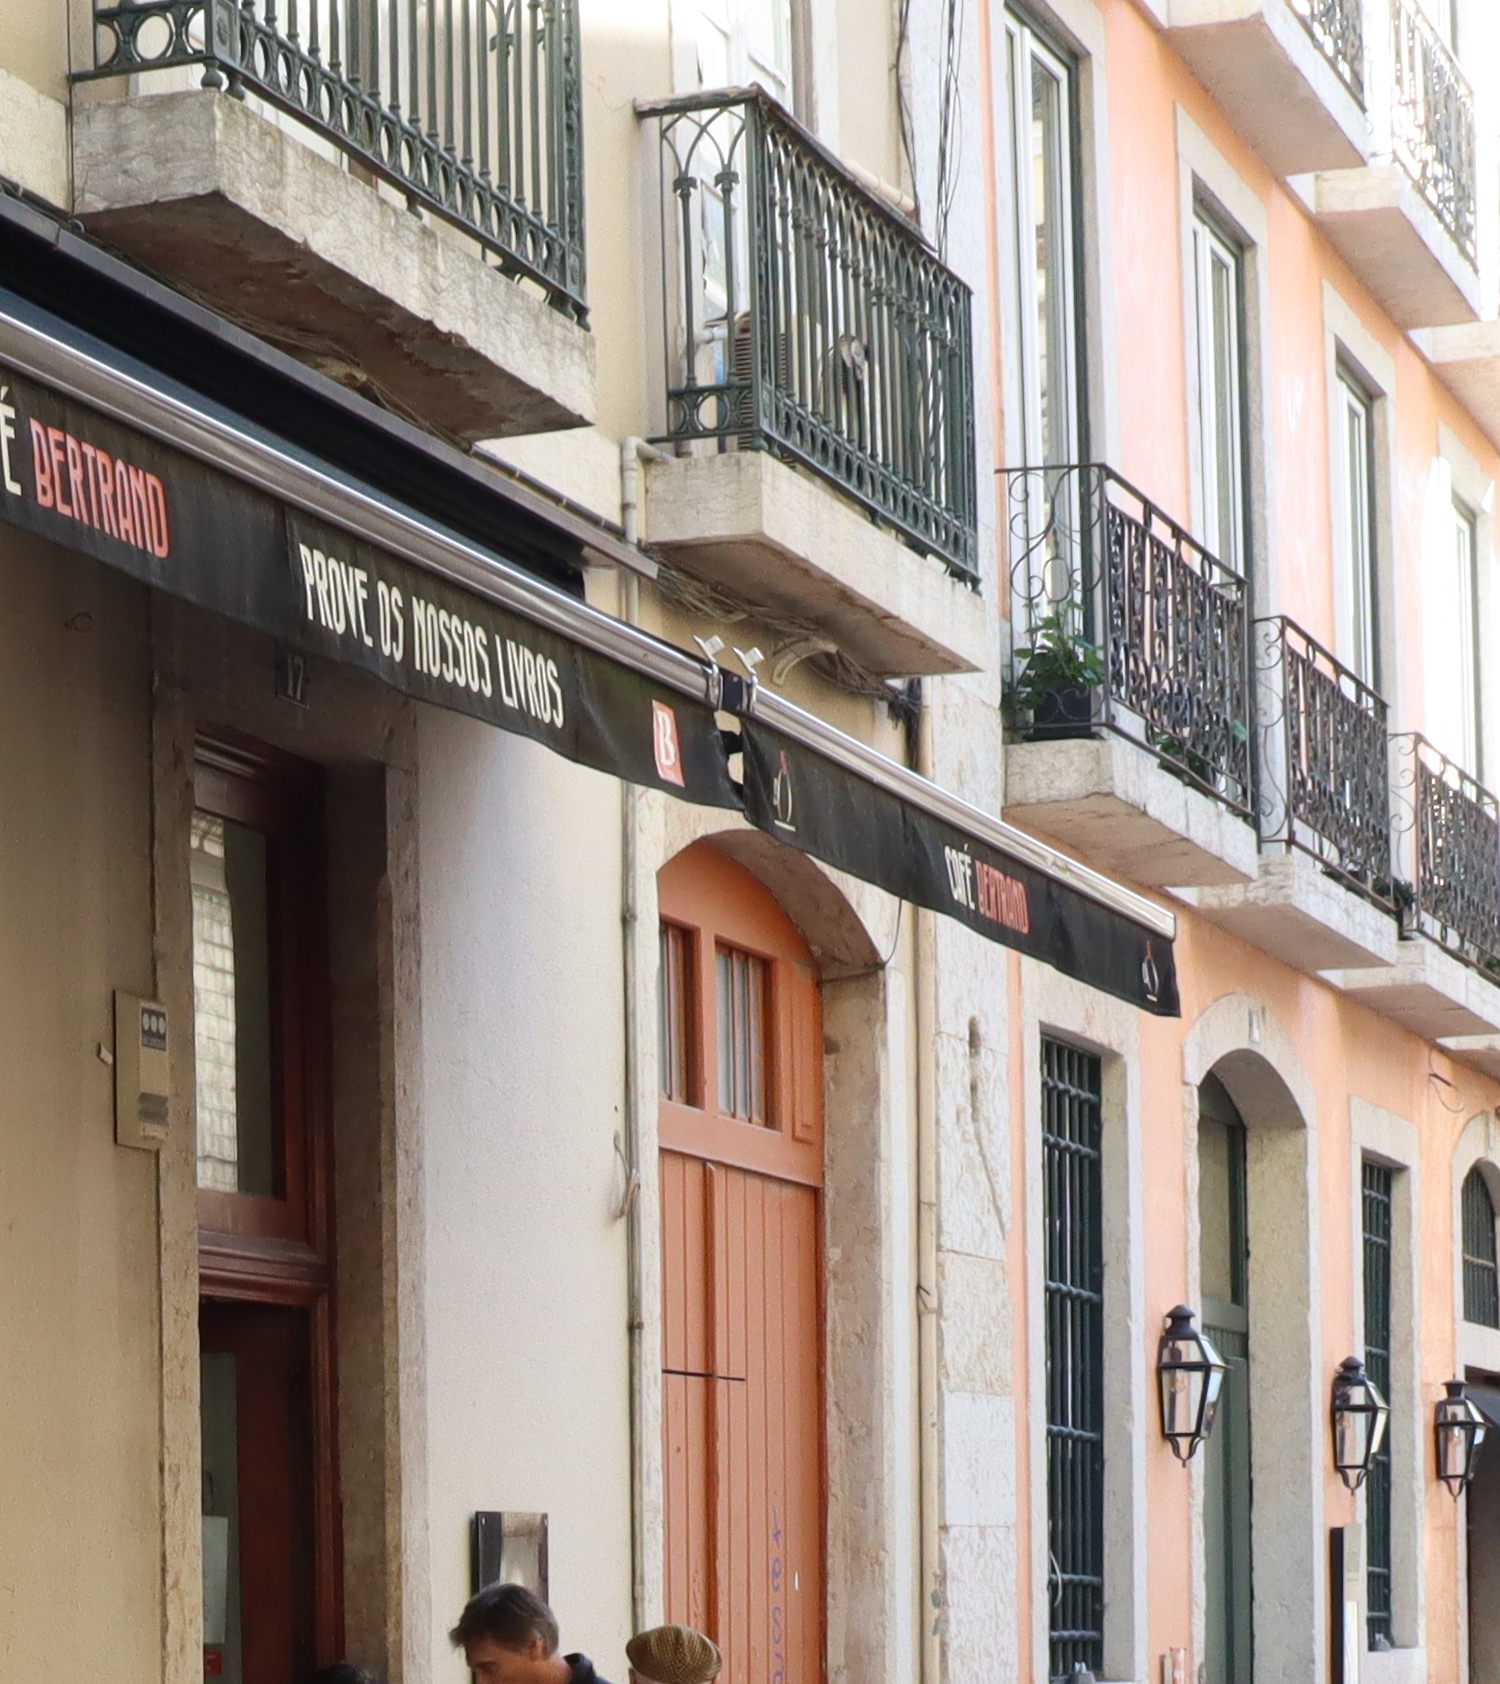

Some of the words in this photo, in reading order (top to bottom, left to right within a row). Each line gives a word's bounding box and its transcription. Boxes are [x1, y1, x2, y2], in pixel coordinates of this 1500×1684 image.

[29, 417, 169, 559] BERTRAND
[298, 543, 374, 648] PROVE
[378, 580, 405, 662] OS
[412, 596, 492, 698] NOSSOS
[495, 634, 564, 729] LIVROS
[656, 709, 676, 766] B
[975, 859, 1032, 935] BERTRAND
